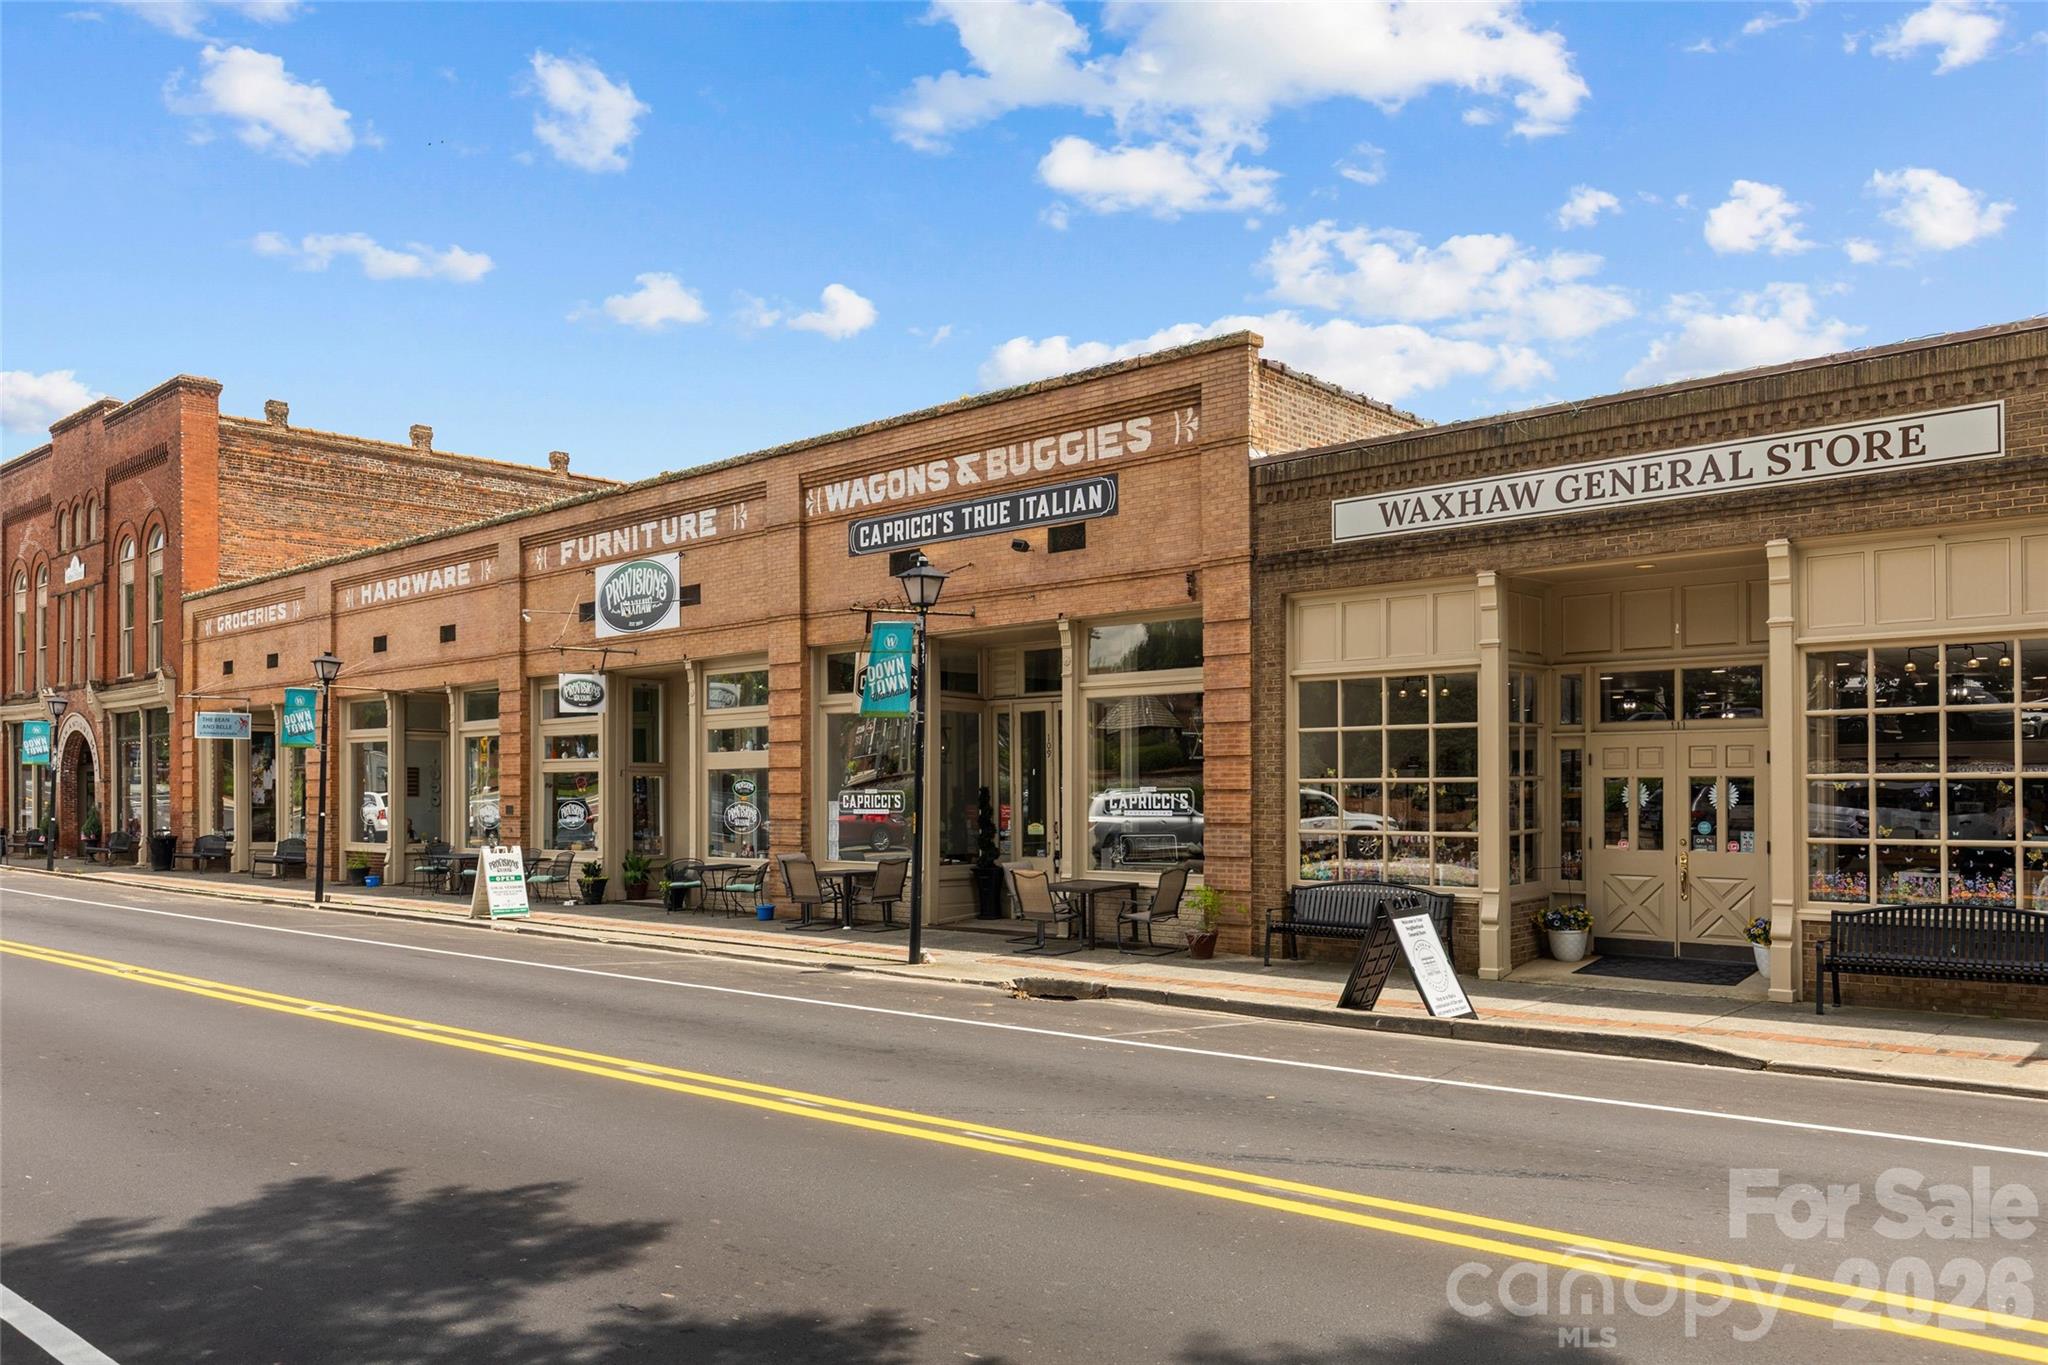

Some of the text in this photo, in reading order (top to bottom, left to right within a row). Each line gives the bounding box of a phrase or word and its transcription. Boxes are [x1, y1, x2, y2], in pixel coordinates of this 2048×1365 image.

[824, 416, 1152, 512] WAGONS & BUGGIES
[1378, 423, 1928, 529] WAXHAW GENERAL STORE
[859, 484, 1103, 548] CAPRICCI'S TRUE ITALIAN
[560, 508, 717, 566] FURNITURE
[361, 562, 471, 605] HARDWARE
[605, 567, 668, 611] PROVISIONS
[217, 602, 287, 632] GROCERIES
[867, 656, 906, 682] DOWN
[868, 672, 909, 696] TOWN
[284, 710, 311, 725] DOWN
[285, 719, 314, 733] TOWN
[23, 735, 47, 749] DOWN
[25, 745, 49, 756] TOWN
[842, 794, 901, 809] CAPRICCI'S
[1109, 792, 1189, 810] CAPRICCI'S
